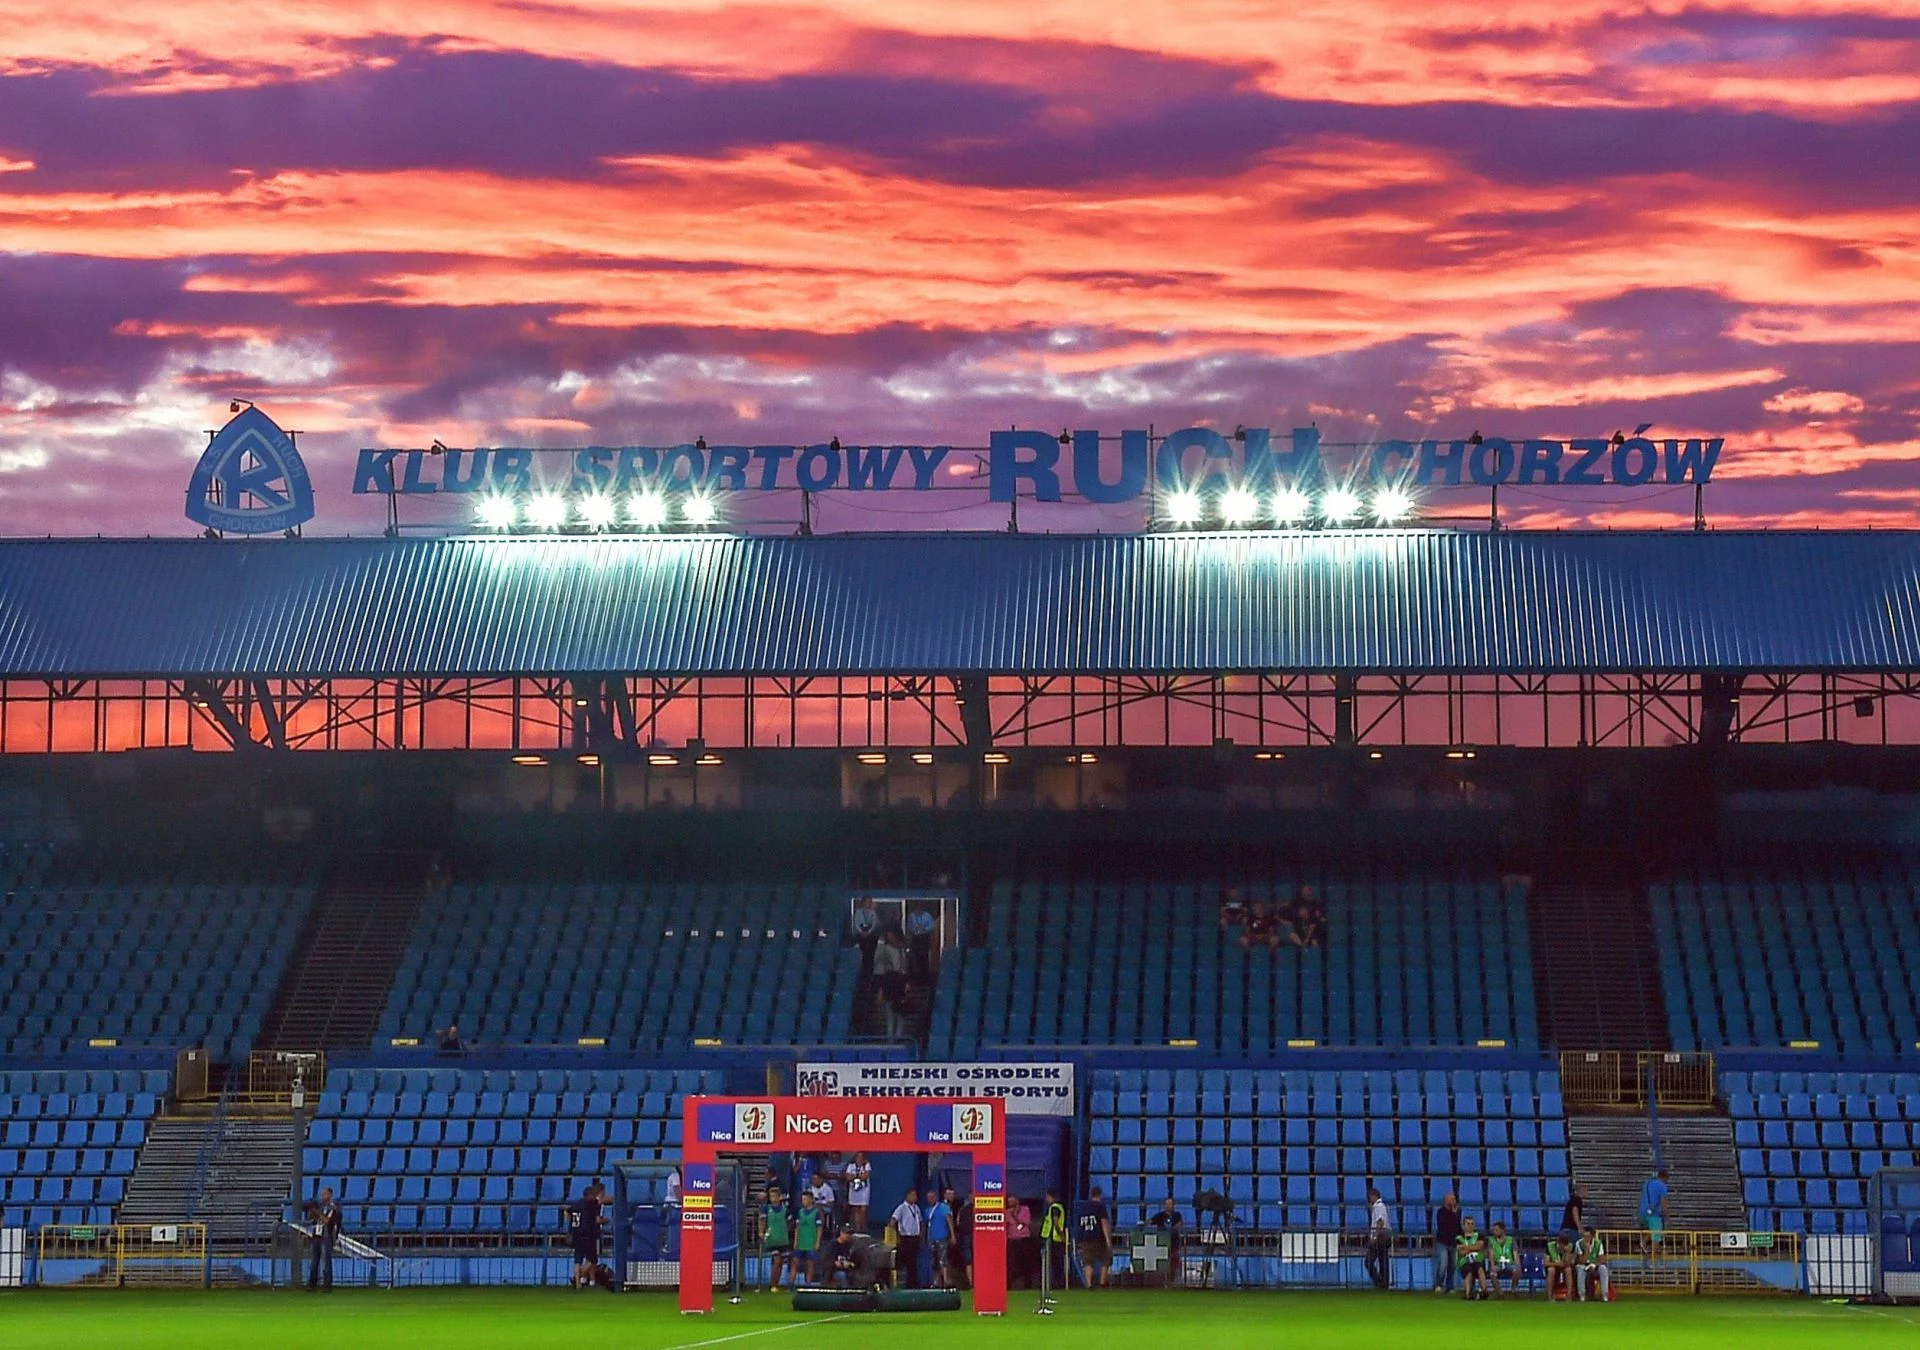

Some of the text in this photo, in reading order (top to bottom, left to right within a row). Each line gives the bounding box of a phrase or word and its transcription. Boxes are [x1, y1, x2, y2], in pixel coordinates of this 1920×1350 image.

[352, 423, 1725, 504] KLUB SPORTOWY RUCH CHORZÓW
[861, 1065, 1060, 1079] MIEJSKI OŚRODEK
[843, 1085, 962, 1097] REKREACJI
[969, 1085, 975, 1097] I
[983, 1085, 1069, 1098] SPORTU
[785, 1113, 901, 1134] Nice 1 LIGA
[711, 1131, 732, 1140] Nice
[740, 1132, 767, 1140] 1 LIGA
[928, 1131, 950, 1141] Nice
[958, 1132, 984, 1140] 1 LIGA
[692, 1179, 711, 1189] Nice
[983, 1180, 1002, 1190] Nice
[159, 1228, 166, 1239] 1
[1729, 1234, 1738, 1246] 3
